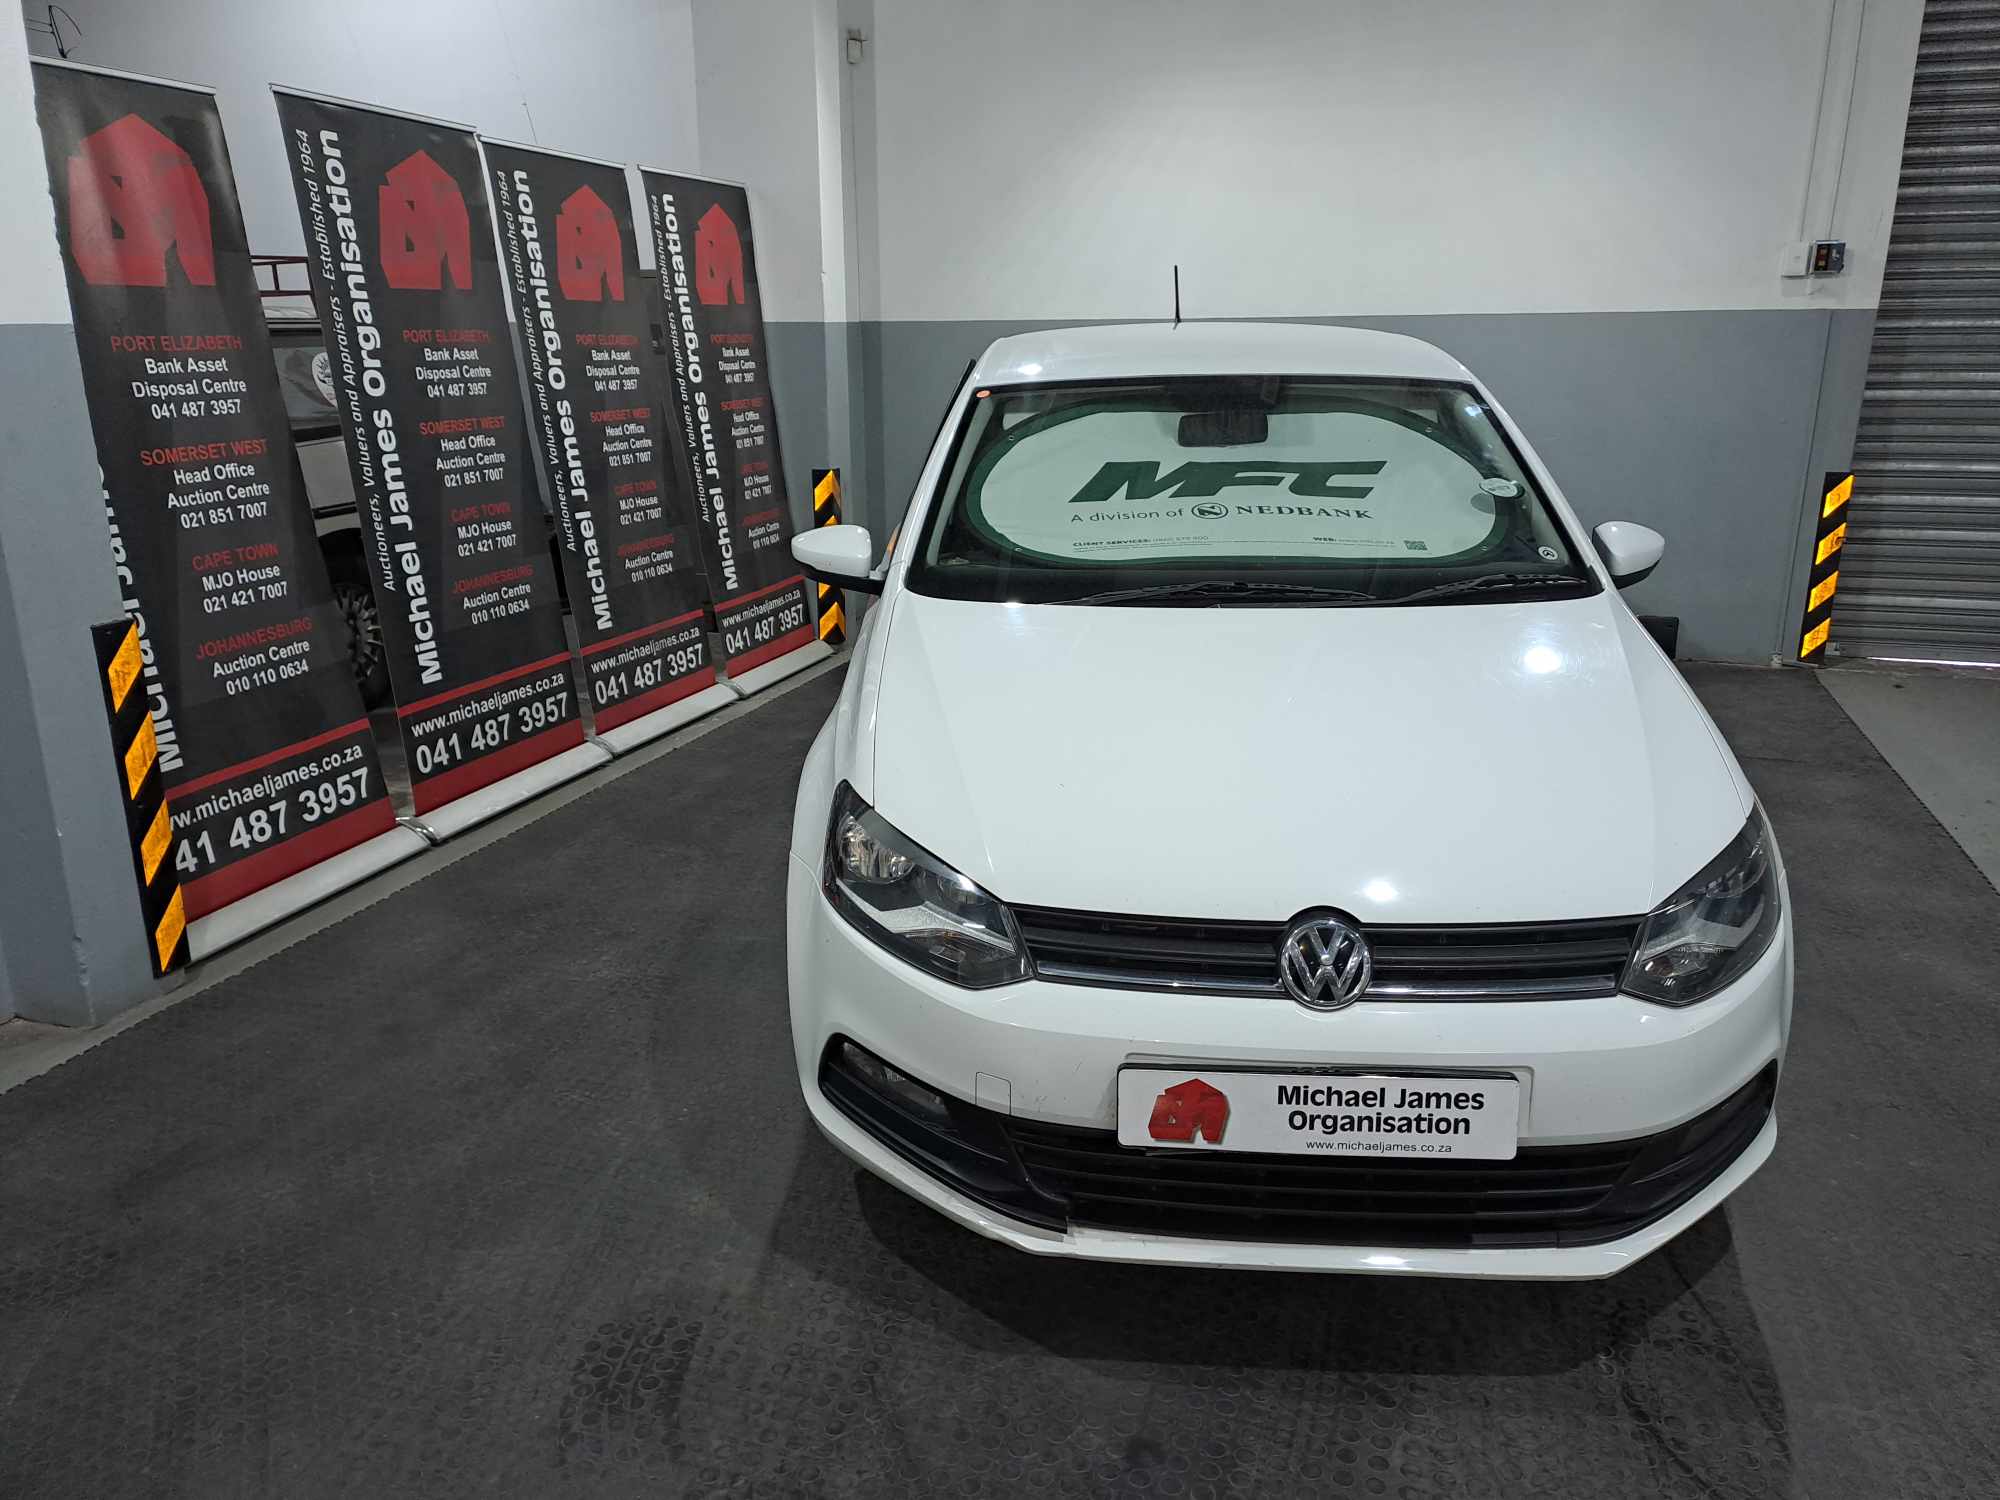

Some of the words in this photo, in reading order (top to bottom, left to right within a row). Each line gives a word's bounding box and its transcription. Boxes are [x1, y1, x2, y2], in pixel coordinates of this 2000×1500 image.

[296, 128, 316, 174] 1964
[497, 170, 511, 206] 1964
[303, 180, 336, 281] Established
[319, 130, 386, 397] Organisation
[503, 210, 527, 294] Established
[513, 170, 566, 390] Organisation
[663, 194, 702, 383] Organisation
[111, 335, 156, 352] PORT
[163, 335, 242, 352] ELIZABETH
[332, 296, 356, 386] Appraisers
[424, 348, 450, 361] Bank
[453, 348, 479, 360] Asset
[522, 305, 543, 380] Appraisers
[592, 350, 610, 360] Bank
[145, 358, 184, 374] Bank
[188, 358, 228, 372] Asset
[416, 366, 460, 382] Disposal
[463, 365, 491, 377] Centre
[132, 380, 199, 400] Disposal
[202, 379, 246, 393] Centre
[345, 389, 363, 422] and
[428, 384, 444, 397] 041
[448, 384, 464, 396] 487
[468, 383, 486, 395] 3957
[535, 383, 549, 411] and
[677, 378, 688, 401] and
[152, 403, 177, 419] 041
[182, 401, 204, 416] 487
[211, 399, 240, 415] 3957
[683, 404, 696, 447] Valuers
[140, 444, 227, 466] SOMERSET
[231, 439, 268, 457] WEST
[441, 437, 466, 451] Head
[468, 435, 495, 448] Office
[542, 414, 559, 465] Valuers
[557, 399, 589, 501] James
[695, 392, 719, 479] James
[174, 467, 211, 485] Head
[214, 463, 255, 479] Office
[356, 426, 376, 487] Valuers
[373, 409, 413, 531] James
[437, 456, 474, 470] Auction
[477, 452, 505, 465] Centre
[168, 489, 223, 508] Auction
[226, 483, 269, 499] Centre
[445, 474, 461, 487] 021
[464, 471, 480, 484] 851
[483, 468, 503, 481] 7007
[1068, 460, 1389, 503] MFC
[181, 511, 205, 528] 021
[209, 507, 233, 524] 851
[237, 502, 266, 519] 7007
[554, 469, 577, 552] Auctioneers,
[1071, 513, 1083, 522] A
[1089, 511, 1160, 522] division
[1166, 508, 1184, 517] of
[1236, 505, 1374, 519] NEDBANK
[369, 492, 396, 592] Auctioneers,
[457, 524, 479, 539] MJO
[482, 521, 511, 534] House
[458, 543, 475, 556] 021
[477, 539, 493, 552] 421
[496, 534, 516, 548] 7007
[709, 488, 739, 591] Michael
[192, 550, 232, 571] CAPE
[237, 544, 279, 564] TOWN
[575, 510, 613, 631] Michael
[202, 572, 233, 591] MJO
[237, 566, 280, 584] House
[464, 592, 499, 609] Auction
[501, 584, 530, 598] Centre
[204, 595, 227, 613] 021
[232, 589, 255, 606] 421
[258, 581, 287, 601] 7007
[395, 541, 443, 685] Michael
[472, 610, 488, 624] 010
[490, 605, 505, 618] 110
[508, 599, 529, 614] 0634
[196, 617, 312, 659] JOHANNESBURG
[726, 627, 751, 654] 041
[755, 616, 775, 641] 487
[779, 604, 803, 633] 3957
[213, 652, 266, 678] Auction
[269, 640, 310, 662] Centre
[591, 626, 700, 674] www.michaeljames.co.za
[226, 676, 250, 695] 010
[253, 669, 276, 687] 110
[280, 659, 308, 680] 0634
[595, 672, 629, 705] 041
[634, 659, 664, 689] 487
[667, 643, 703, 676] 3957
[411, 672, 564, 737] www.michaeljames.co.za
[415, 724, 464, 774] 041
[471, 713, 510, 752] 487
[519, 692, 568, 734] 3957
[170, 745, 363, 831] w.michaeljames.co.za
[175, 831, 217, 873] 41
[229, 799, 288, 850] 487
[299, 766, 369, 822] 3957
[1277, 1085, 1386, 1109] Michael
[1394, 1088, 1485, 1110] James
[1288, 1110, 1471, 1135] Organisation
[1306, 1140, 1452, 1154] www.michaeljames.co.za
